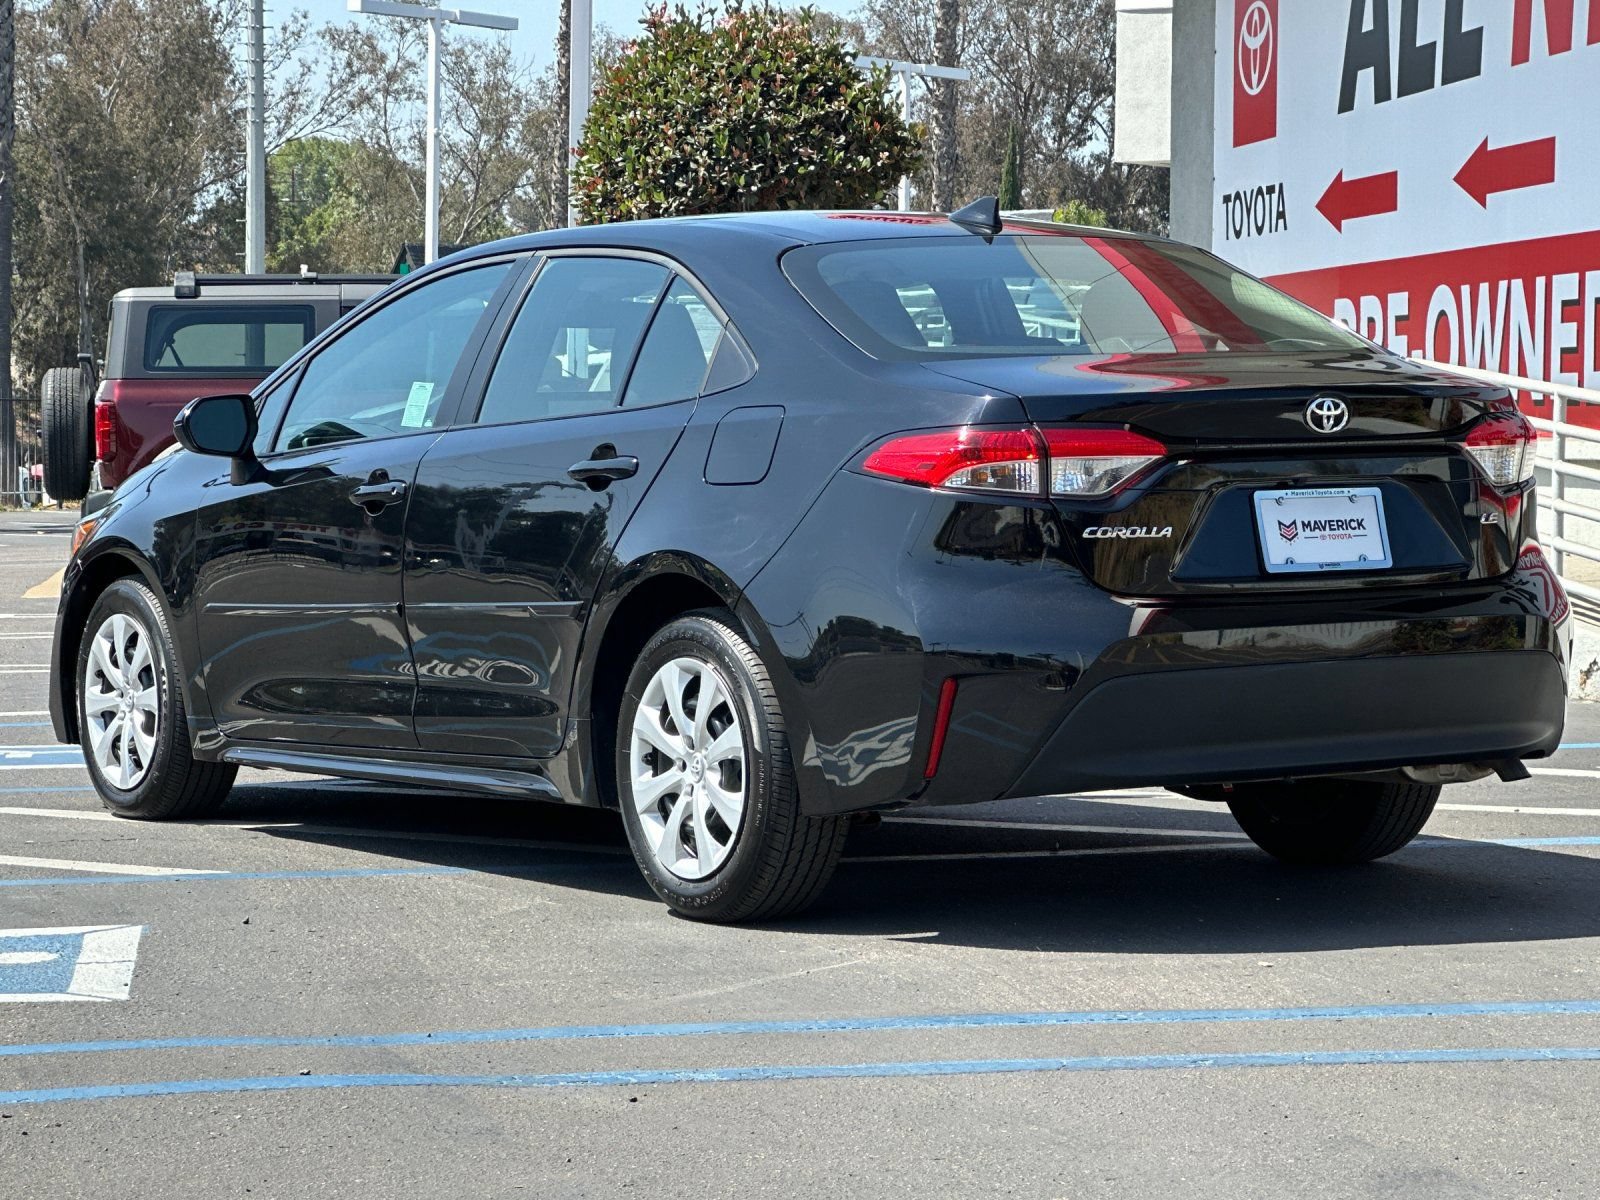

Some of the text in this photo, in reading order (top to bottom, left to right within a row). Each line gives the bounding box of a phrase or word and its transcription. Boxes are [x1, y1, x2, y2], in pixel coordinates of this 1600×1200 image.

[1222, 182, 1288, 241] TOYOTA
[1480, 512, 1499, 524] LE
[1301, 518, 1366, 532] MAVERICK
[1082, 526, 1173, 539] COROLLA
